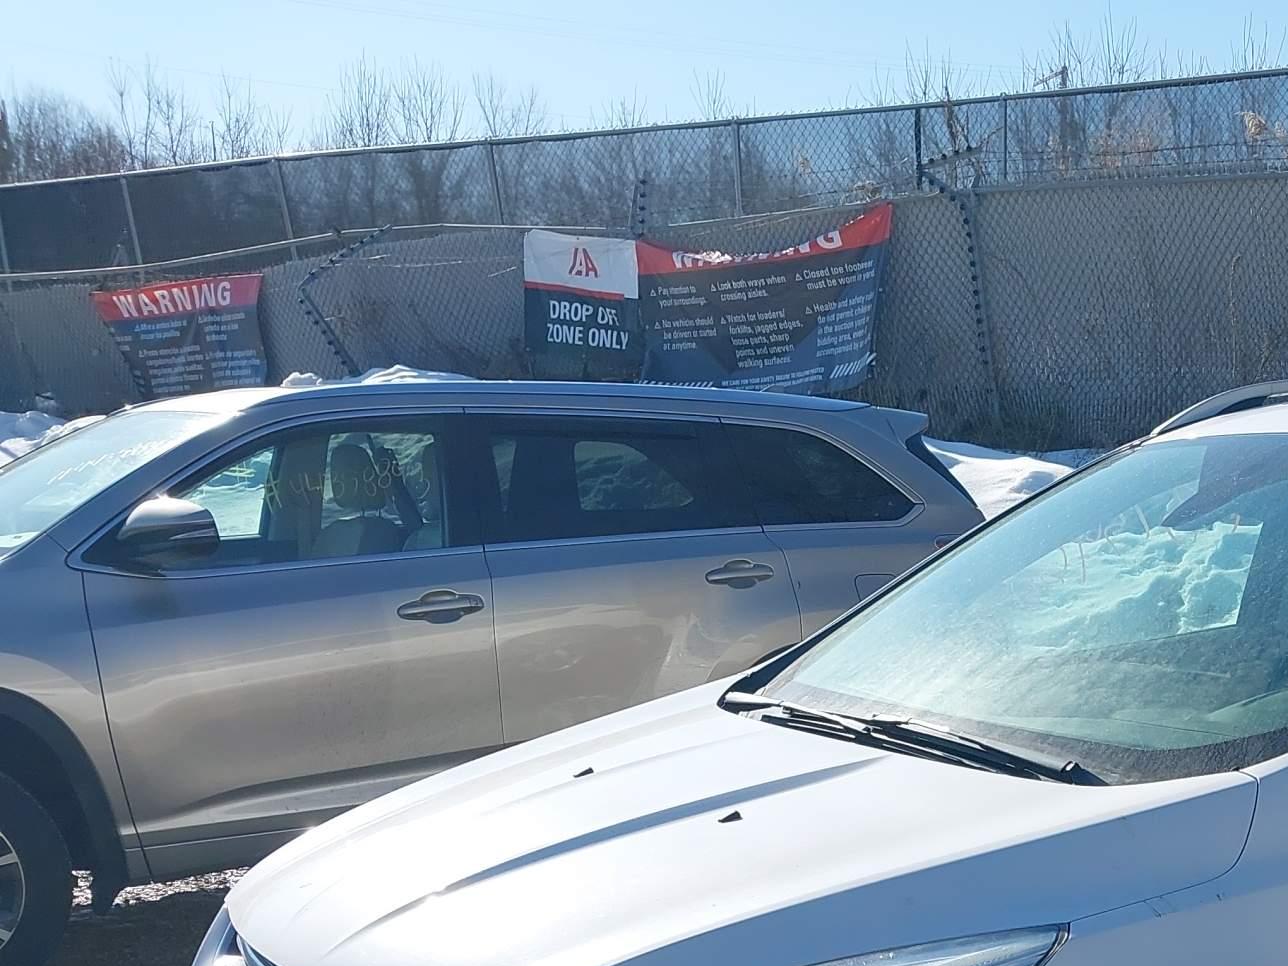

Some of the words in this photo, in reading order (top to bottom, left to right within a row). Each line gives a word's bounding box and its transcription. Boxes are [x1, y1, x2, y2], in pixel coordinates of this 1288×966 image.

[803, 265, 830, 280] Closed
[831, 265, 845, 275] toe
[717, 280, 731, 291] Look
[733, 279, 747, 290] both
[748, 277, 766, 289] ways
[766, 275, 786, 285] when
[806, 279, 826, 290] must
[828, 276, 838, 287] be
[838, 275, 857, 286] worn
[658, 286, 669, 297] Pay
[720, 290, 747, 302] crossing
[112, 281, 232, 318] WARNING
[813, 300, 837, 313] Health
[838, 298, 848, 308] and
[549, 299, 594, 322] DROP
[597, 306, 620, 327] OFF
[726, 313, 747, 323] Watch
[748, 312, 757, 322] for
[817, 315, 826, 325] do
[663, 331, 671, 340] be
[673, 329, 692, 339] driven
[755, 321, 778, 335] jagged
[824, 325, 834, 334] the
[546, 323, 584, 345] ZONE
[588, 327, 630, 350] ONLY
[731, 335, 749, 346] loose
[770, 332, 790, 345] sharp
[663, 342, 670, 350] at
[735, 347, 755, 359] points
[757, 346, 769, 355] and
[770, 344, 795, 355] uneven
[738, 357, 763, 369] walking
